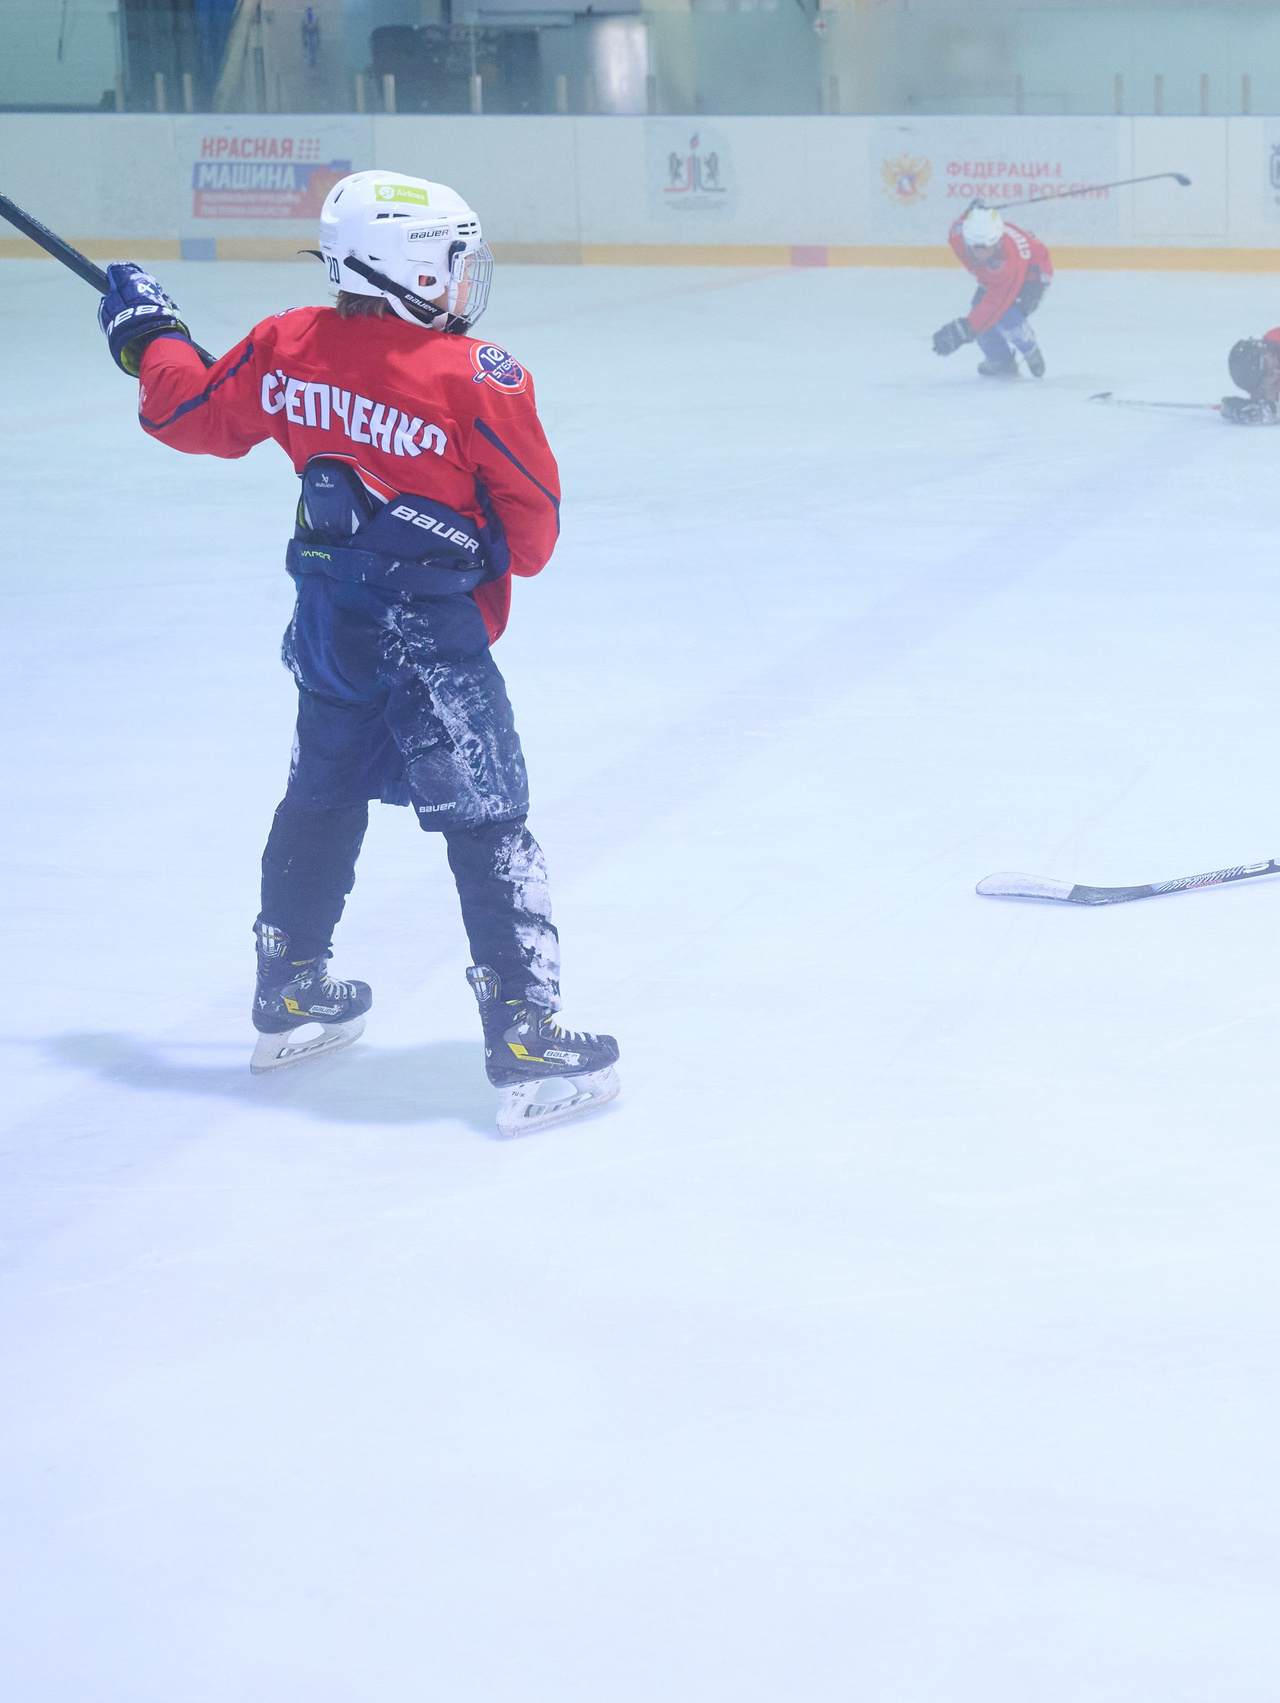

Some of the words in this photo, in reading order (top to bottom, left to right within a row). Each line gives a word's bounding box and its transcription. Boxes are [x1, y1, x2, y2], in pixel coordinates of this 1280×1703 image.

[200, 164, 297, 189] МАШИНА
[396, 188, 425, 201] Airlines
[946, 183, 1024, 198] ХОККЕЯ
[1029, 183, 1110, 198] РОССИИ
[326, 256, 341, 284] 20
[480, 347, 505, 366] 10
[261, 370, 449, 458] СЕПЧЕНКО
[300, 550, 332, 561] VAPOR
